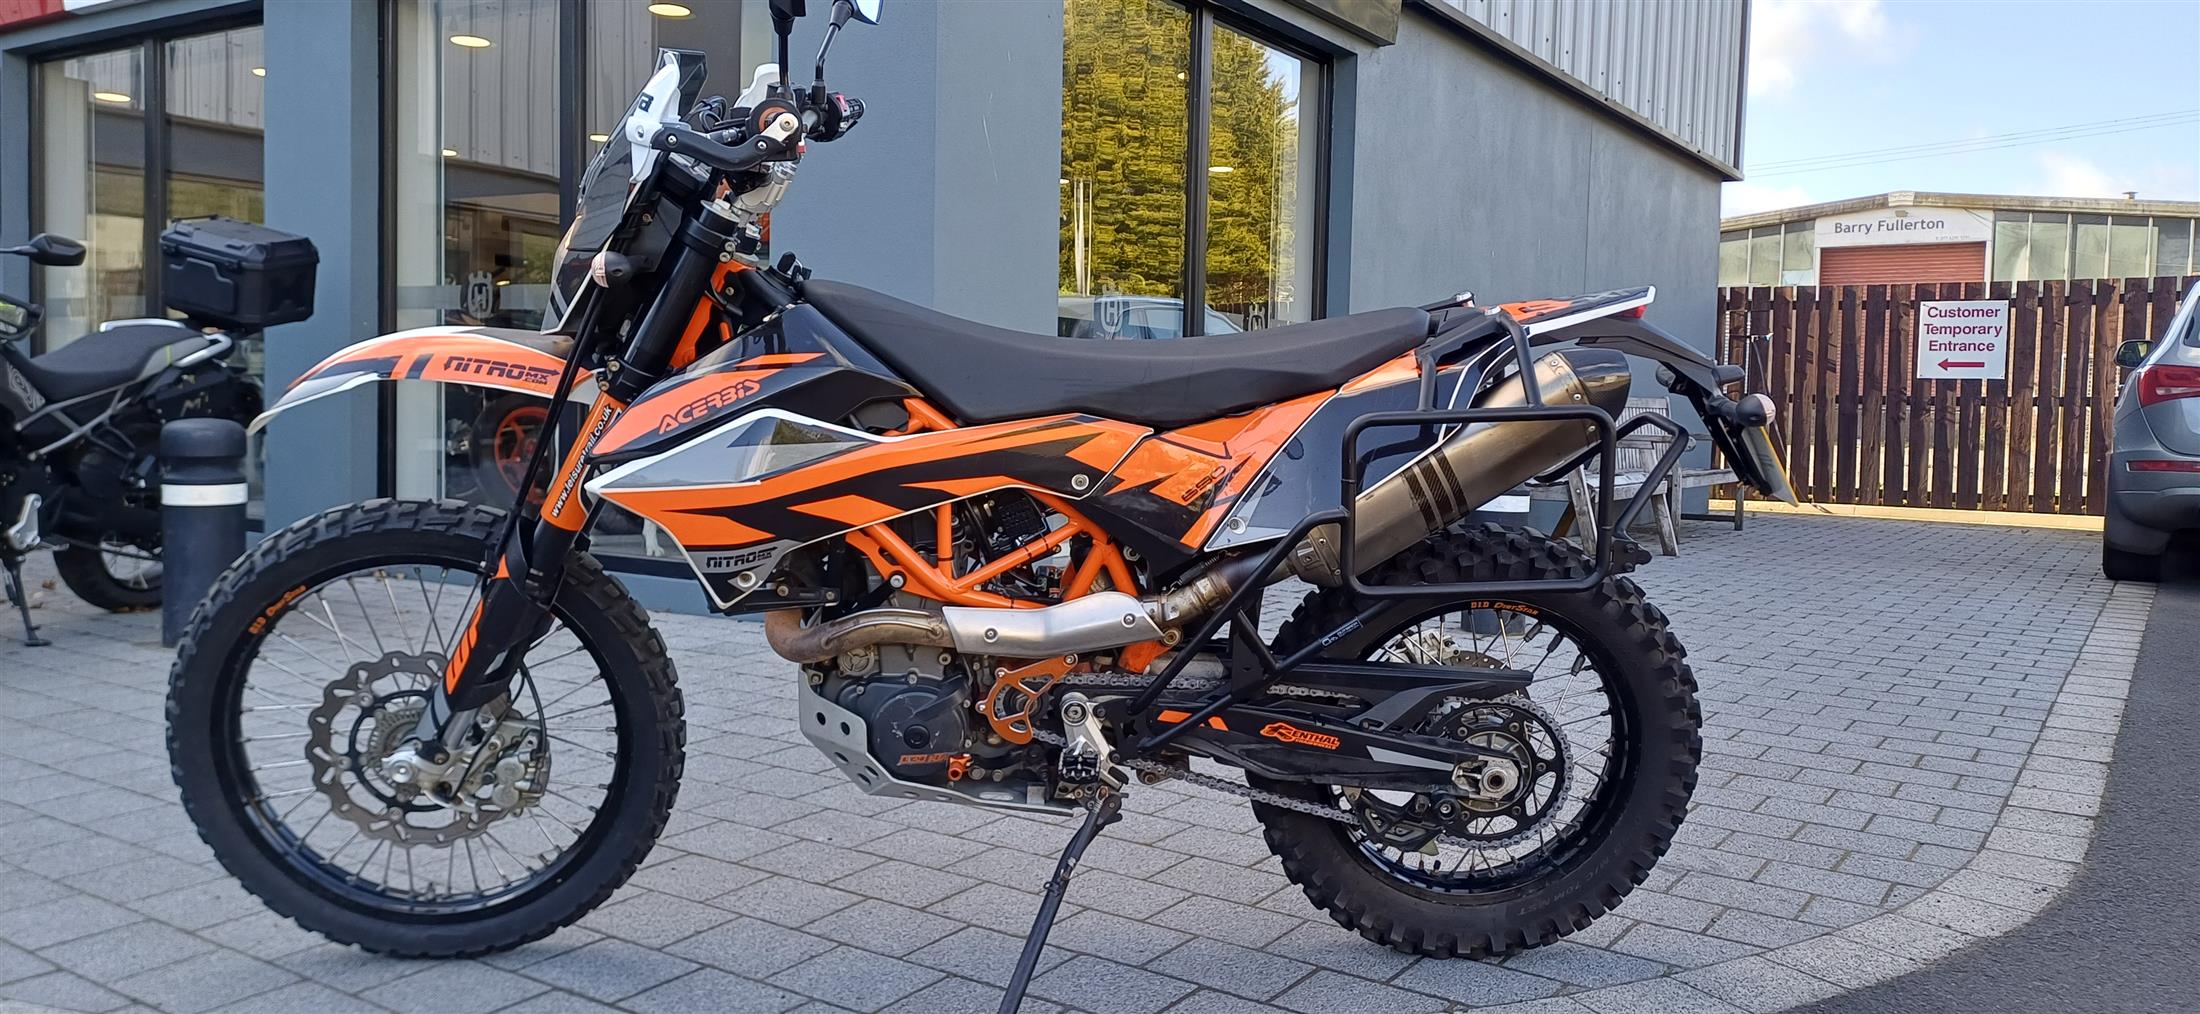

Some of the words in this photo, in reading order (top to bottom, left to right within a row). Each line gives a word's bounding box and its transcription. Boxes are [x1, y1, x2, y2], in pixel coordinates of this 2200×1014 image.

[1834, 222, 1873, 235] Barry
[1877, 219, 1945, 232] Fullerton
[1927, 306, 2001, 318] Customer
[1923, 323, 2003, 338] Temporary
[1928, 340, 1996, 352] Entrance
